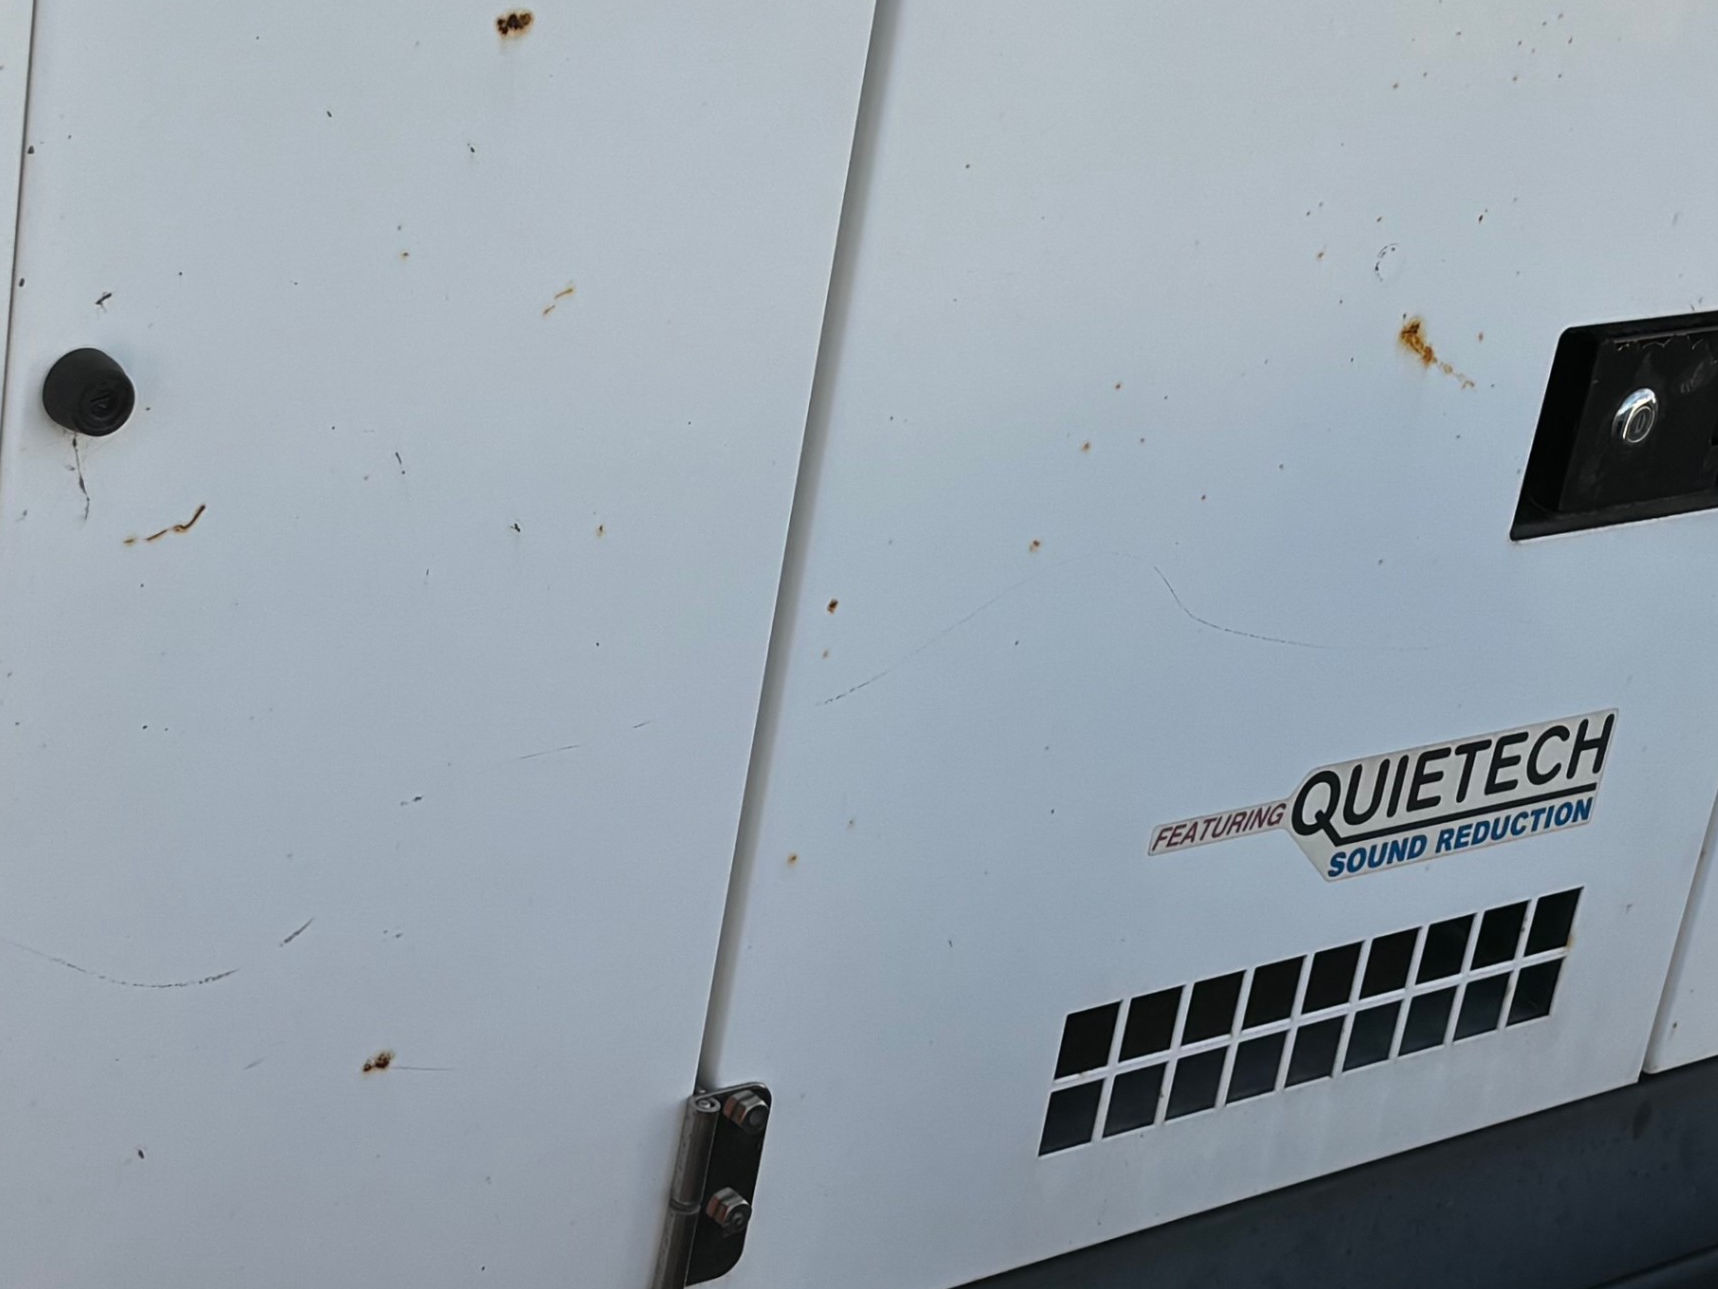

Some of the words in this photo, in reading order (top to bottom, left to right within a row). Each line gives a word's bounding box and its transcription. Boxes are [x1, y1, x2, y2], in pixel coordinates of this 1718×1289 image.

[1291, 712, 1616, 847] QUIETECH
[1151, 801, 1287, 852] FEATURING
[1327, 833, 1428, 879] SOUND
[1434, 796, 1594, 853] REDUCTION
